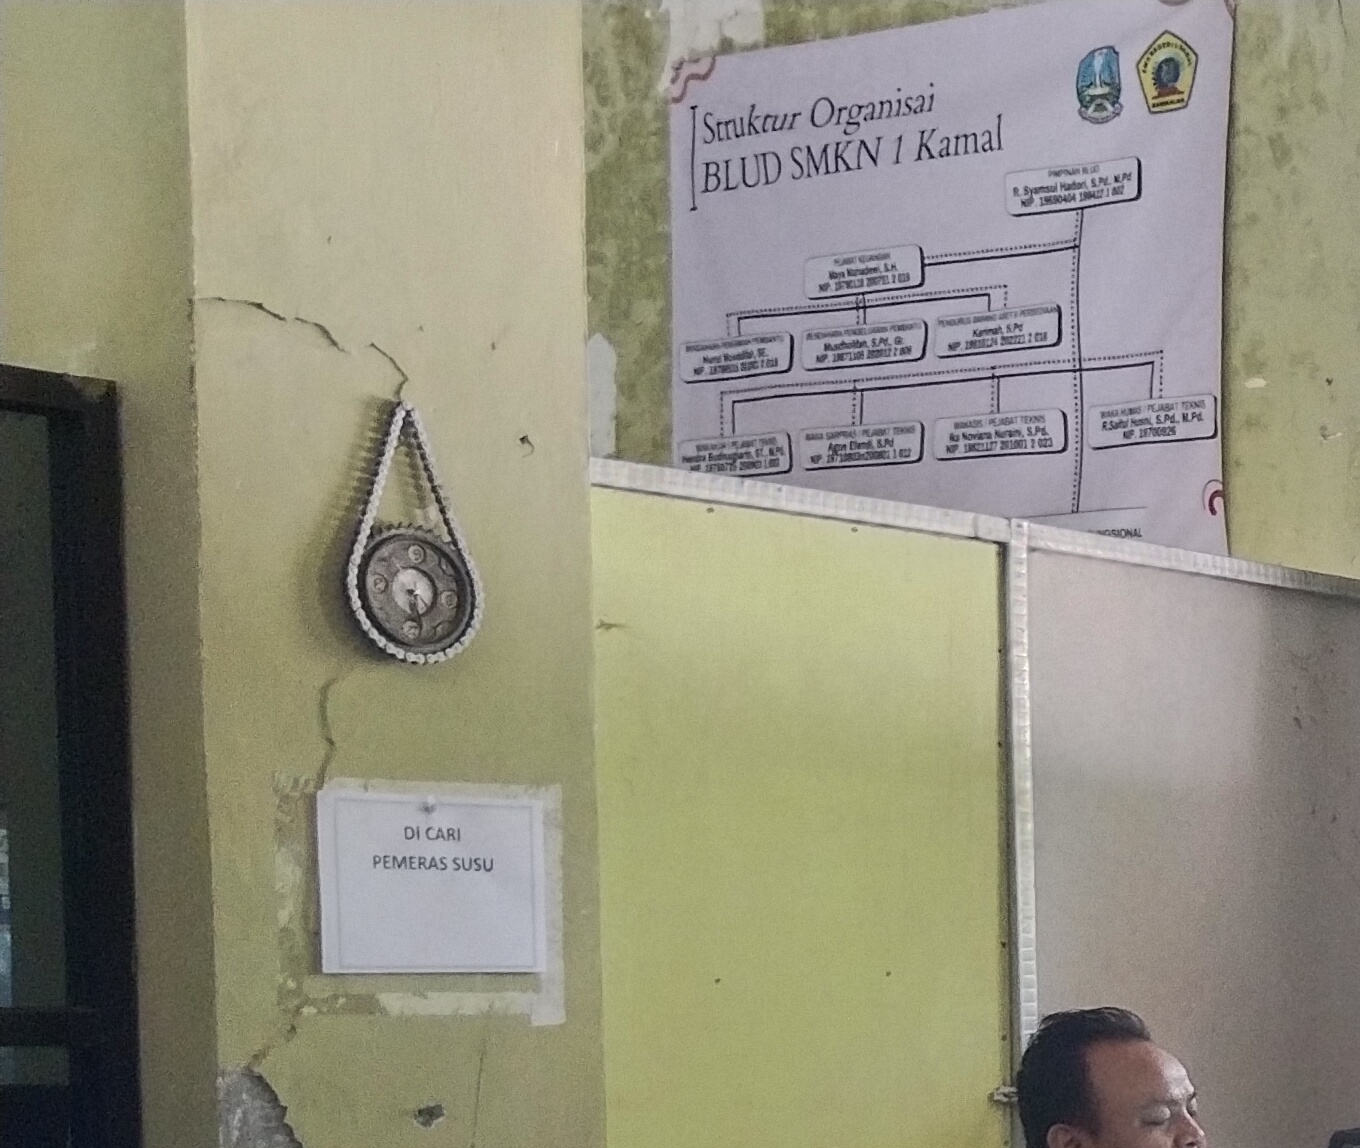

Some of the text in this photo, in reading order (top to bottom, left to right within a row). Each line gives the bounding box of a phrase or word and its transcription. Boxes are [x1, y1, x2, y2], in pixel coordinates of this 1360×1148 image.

[702, 82, 936, 145] Struktur Organisai
[701, 112, 1005, 194] BLUD SMKN 1 Kamal
[403, 826, 462, 842] DI CARI
[372, 854, 495, 873] PEMERAS SUSU
